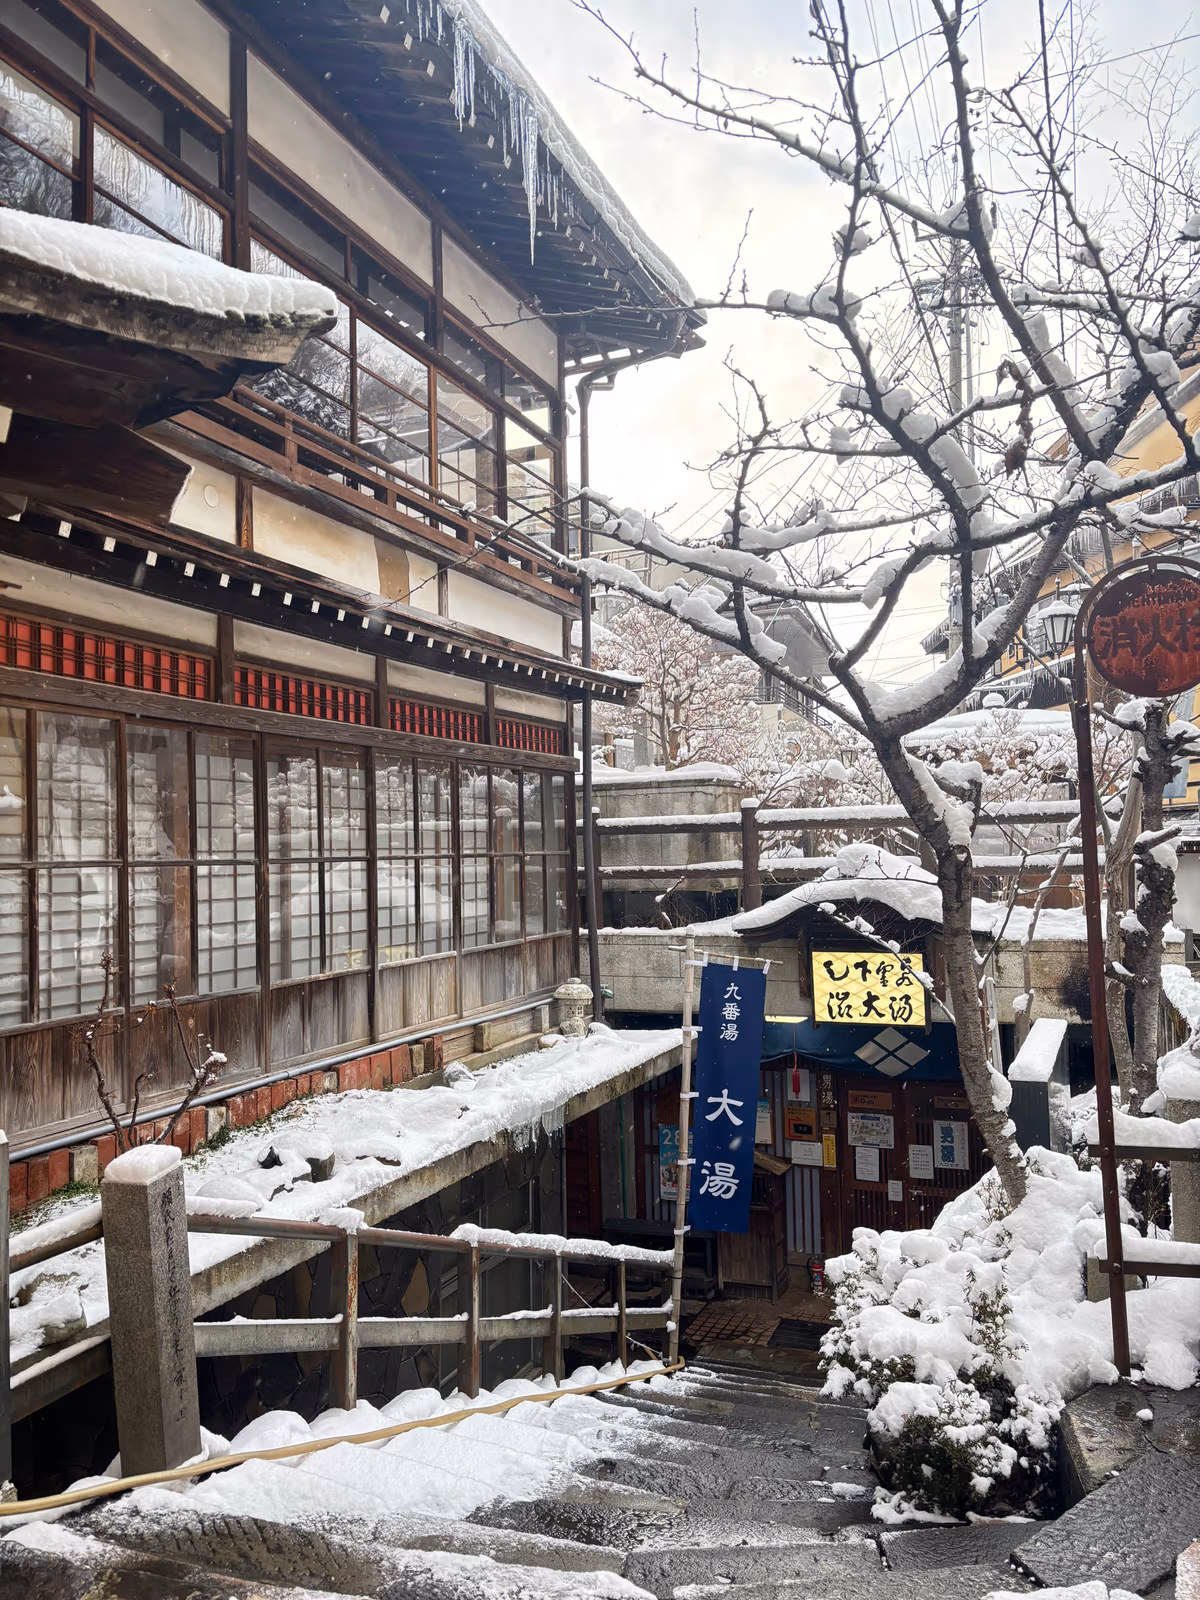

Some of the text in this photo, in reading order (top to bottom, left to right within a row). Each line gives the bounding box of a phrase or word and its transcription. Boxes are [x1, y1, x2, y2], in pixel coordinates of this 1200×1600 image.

[719, 982, 742, 1041] 九番湯
[821, 1074, 834, 1105] 男湯
[699, 1088, 744, 1200] 大湯
